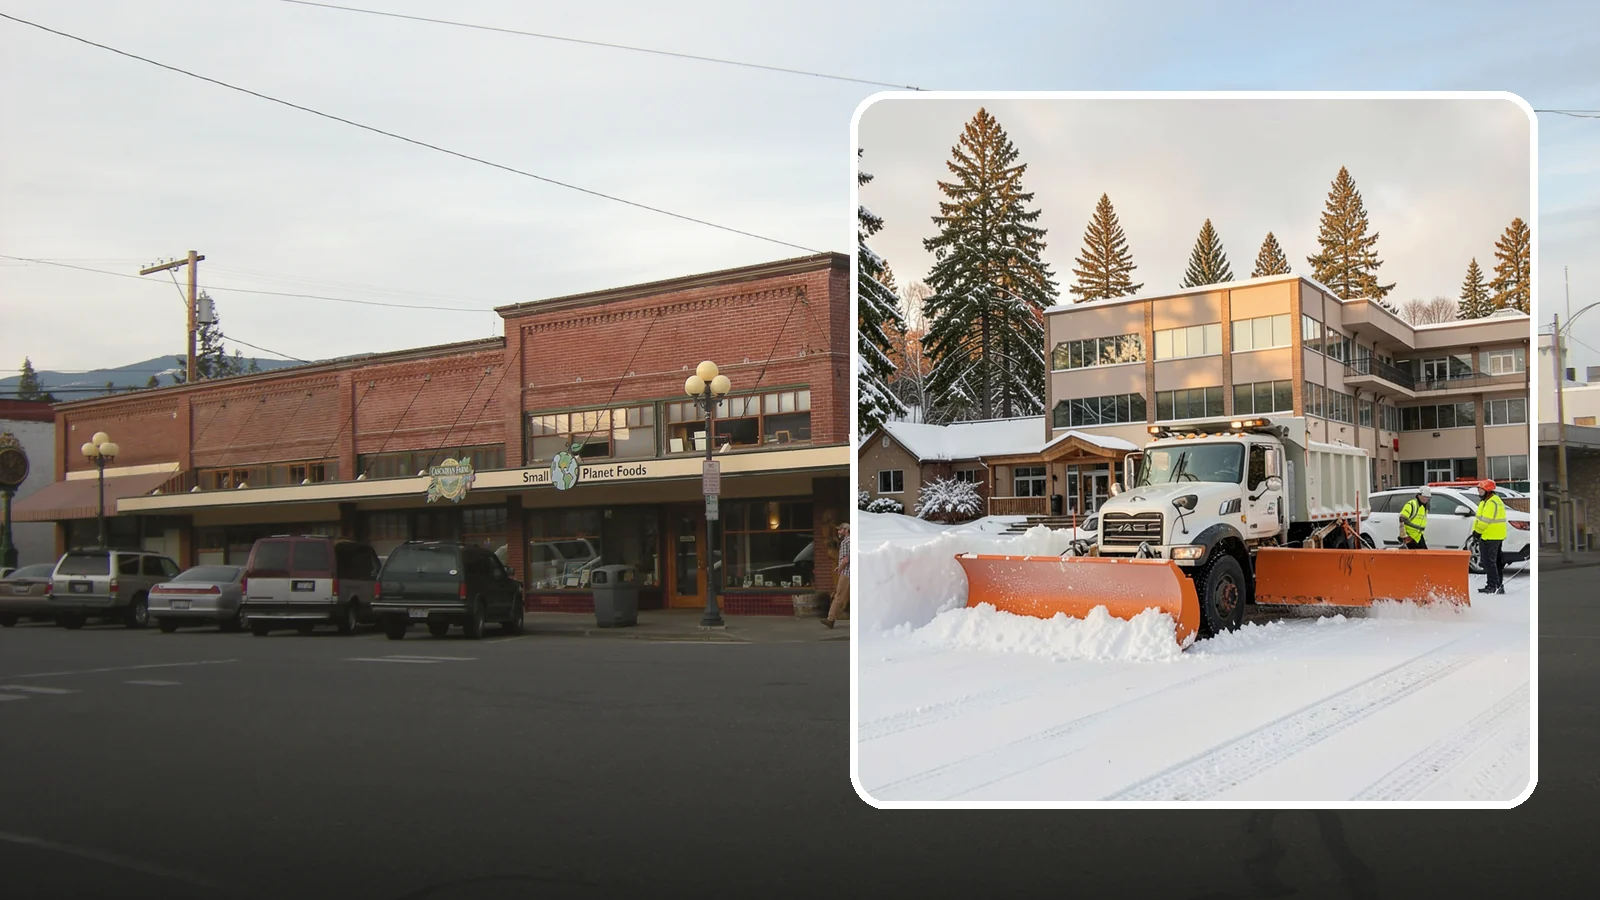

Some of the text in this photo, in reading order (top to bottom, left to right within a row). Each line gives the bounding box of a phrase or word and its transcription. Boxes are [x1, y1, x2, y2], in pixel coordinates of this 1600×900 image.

[523, 464, 647, 483] Small Planet Foods
